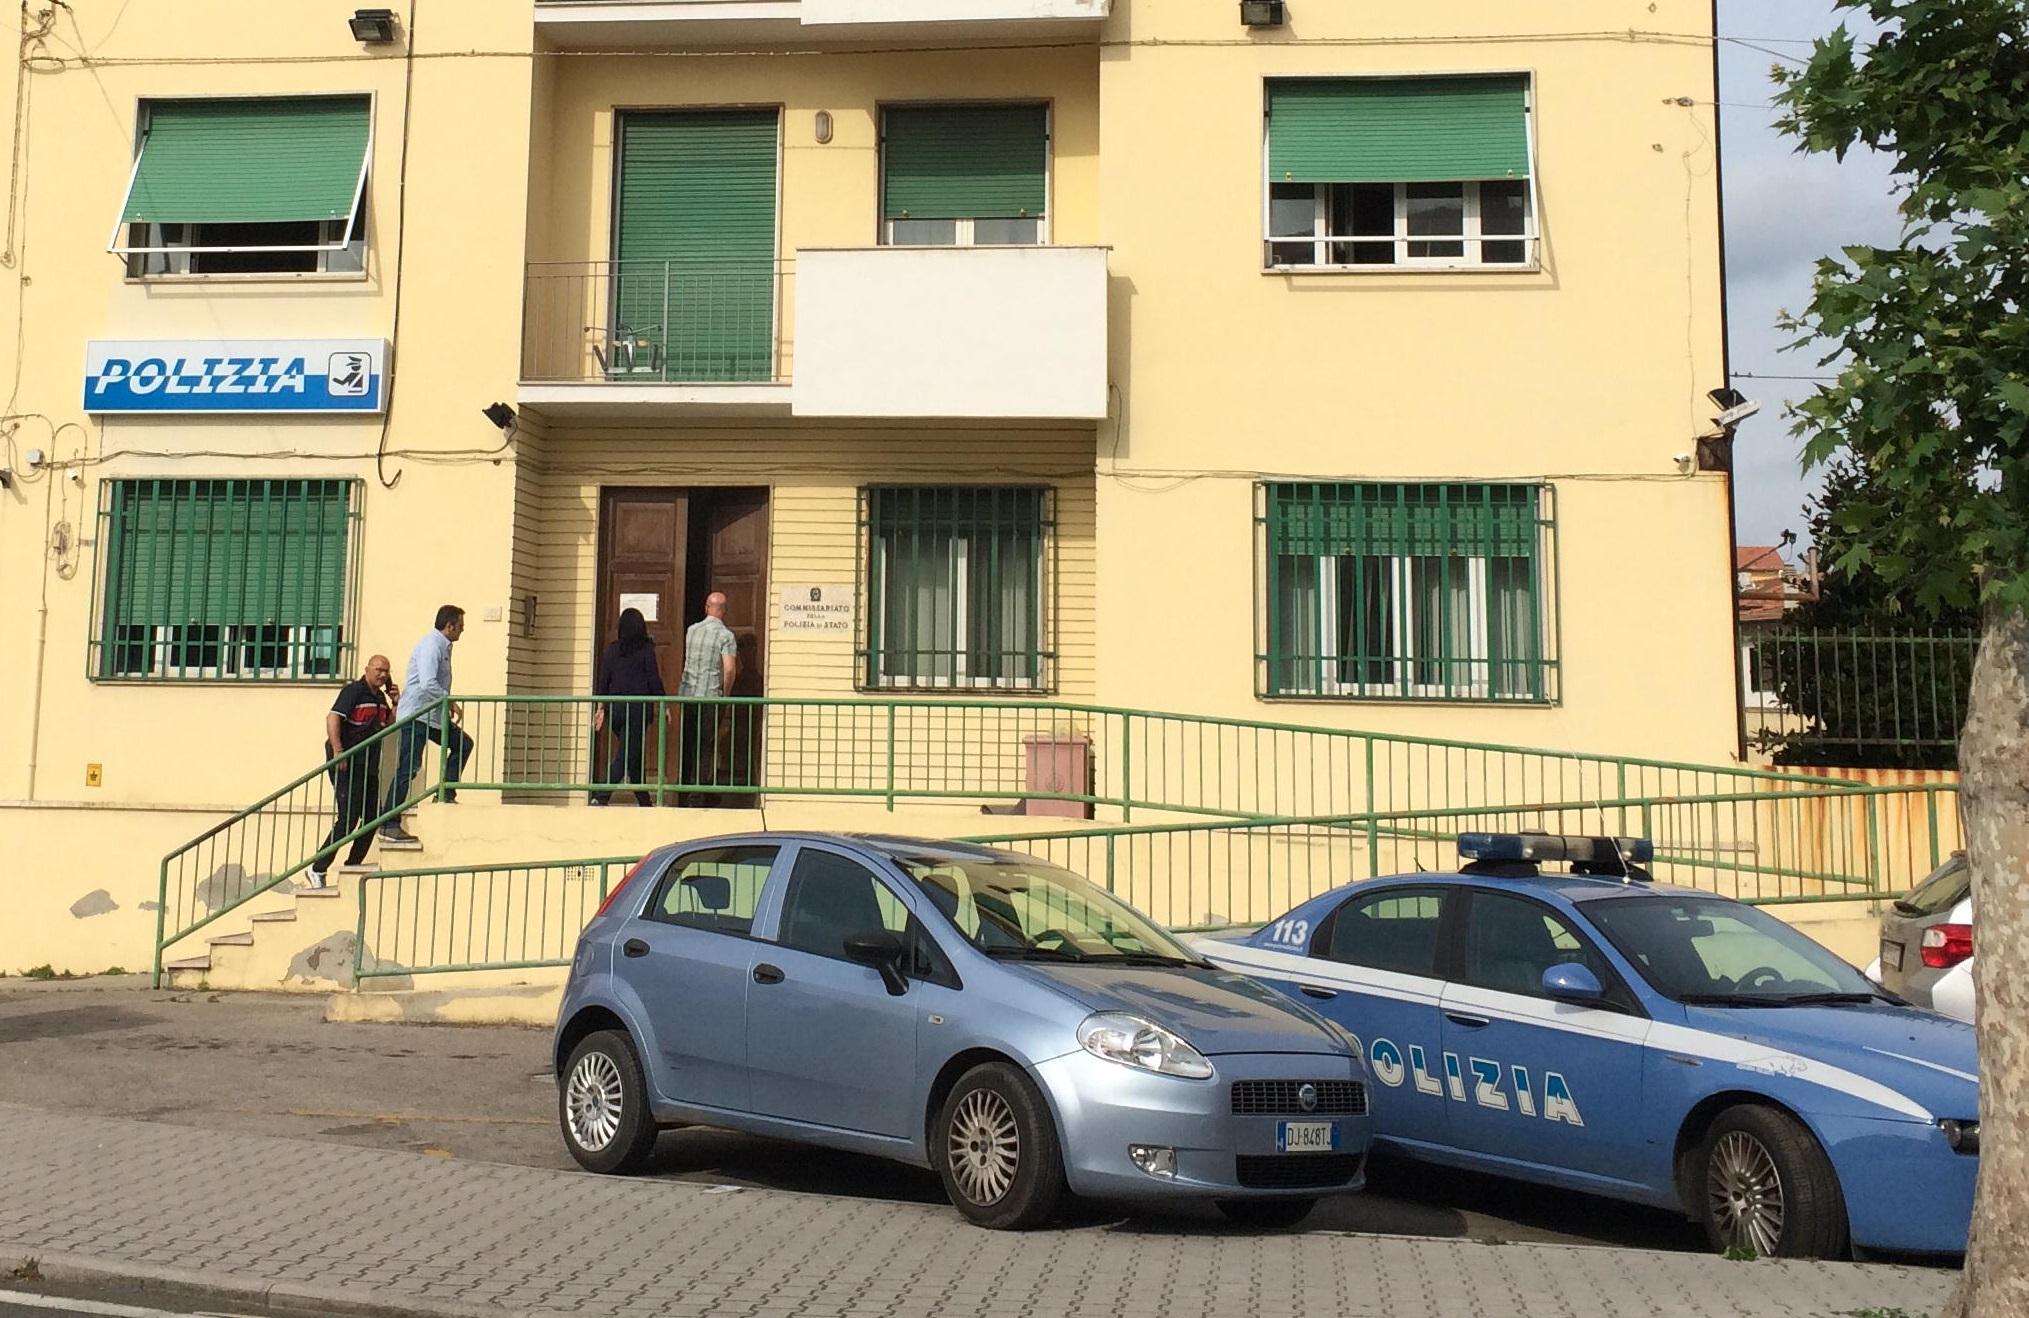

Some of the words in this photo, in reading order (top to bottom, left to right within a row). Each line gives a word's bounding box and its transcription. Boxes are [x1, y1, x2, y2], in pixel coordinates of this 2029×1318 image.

[94, 357, 305, 395] POLIZIA
[783, 603, 850, 613] COMMISSARIATO
[783, 620, 815, 629] POLIZIA
[824, 621, 849, 629] STATO
[1272, 918, 1309, 946] 113
[1353, 1034, 1584, 1127] OLIZIA
